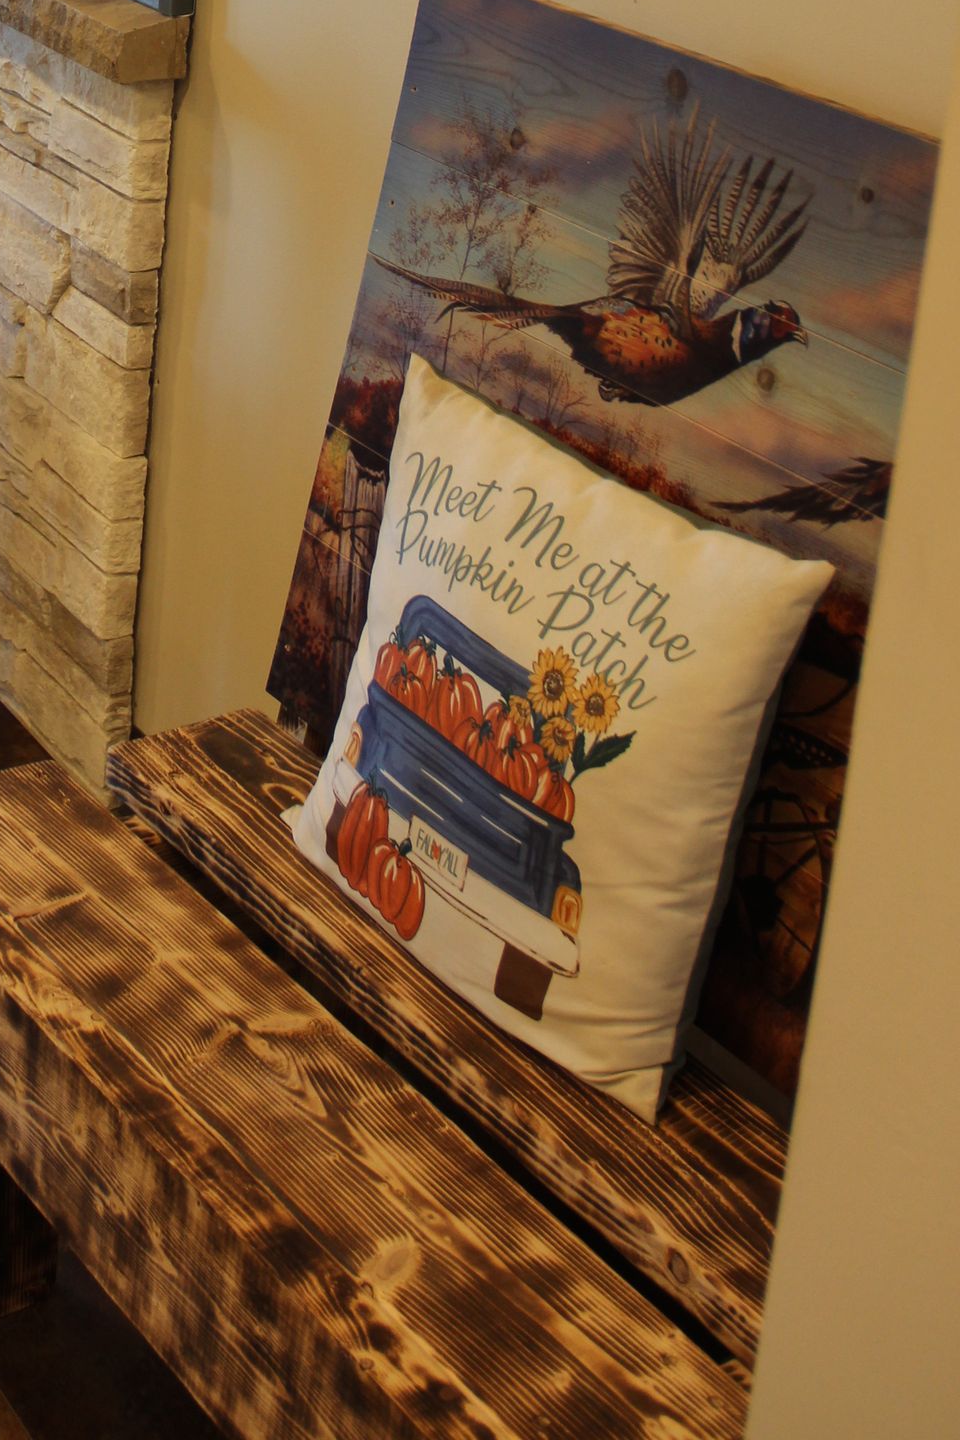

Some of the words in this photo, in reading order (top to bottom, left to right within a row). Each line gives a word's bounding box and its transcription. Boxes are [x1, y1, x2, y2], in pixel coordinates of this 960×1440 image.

[395, 509, 536, 614] Pumpkin
[536, 584, 658, 710] Patch
[404, 451, 502, 522] Meet
[504, 486, 580, 570] Me
[578, 559, 636, 606] at
[627, 580, 697, 663] the
[416, 828, 434, 860] FALL
